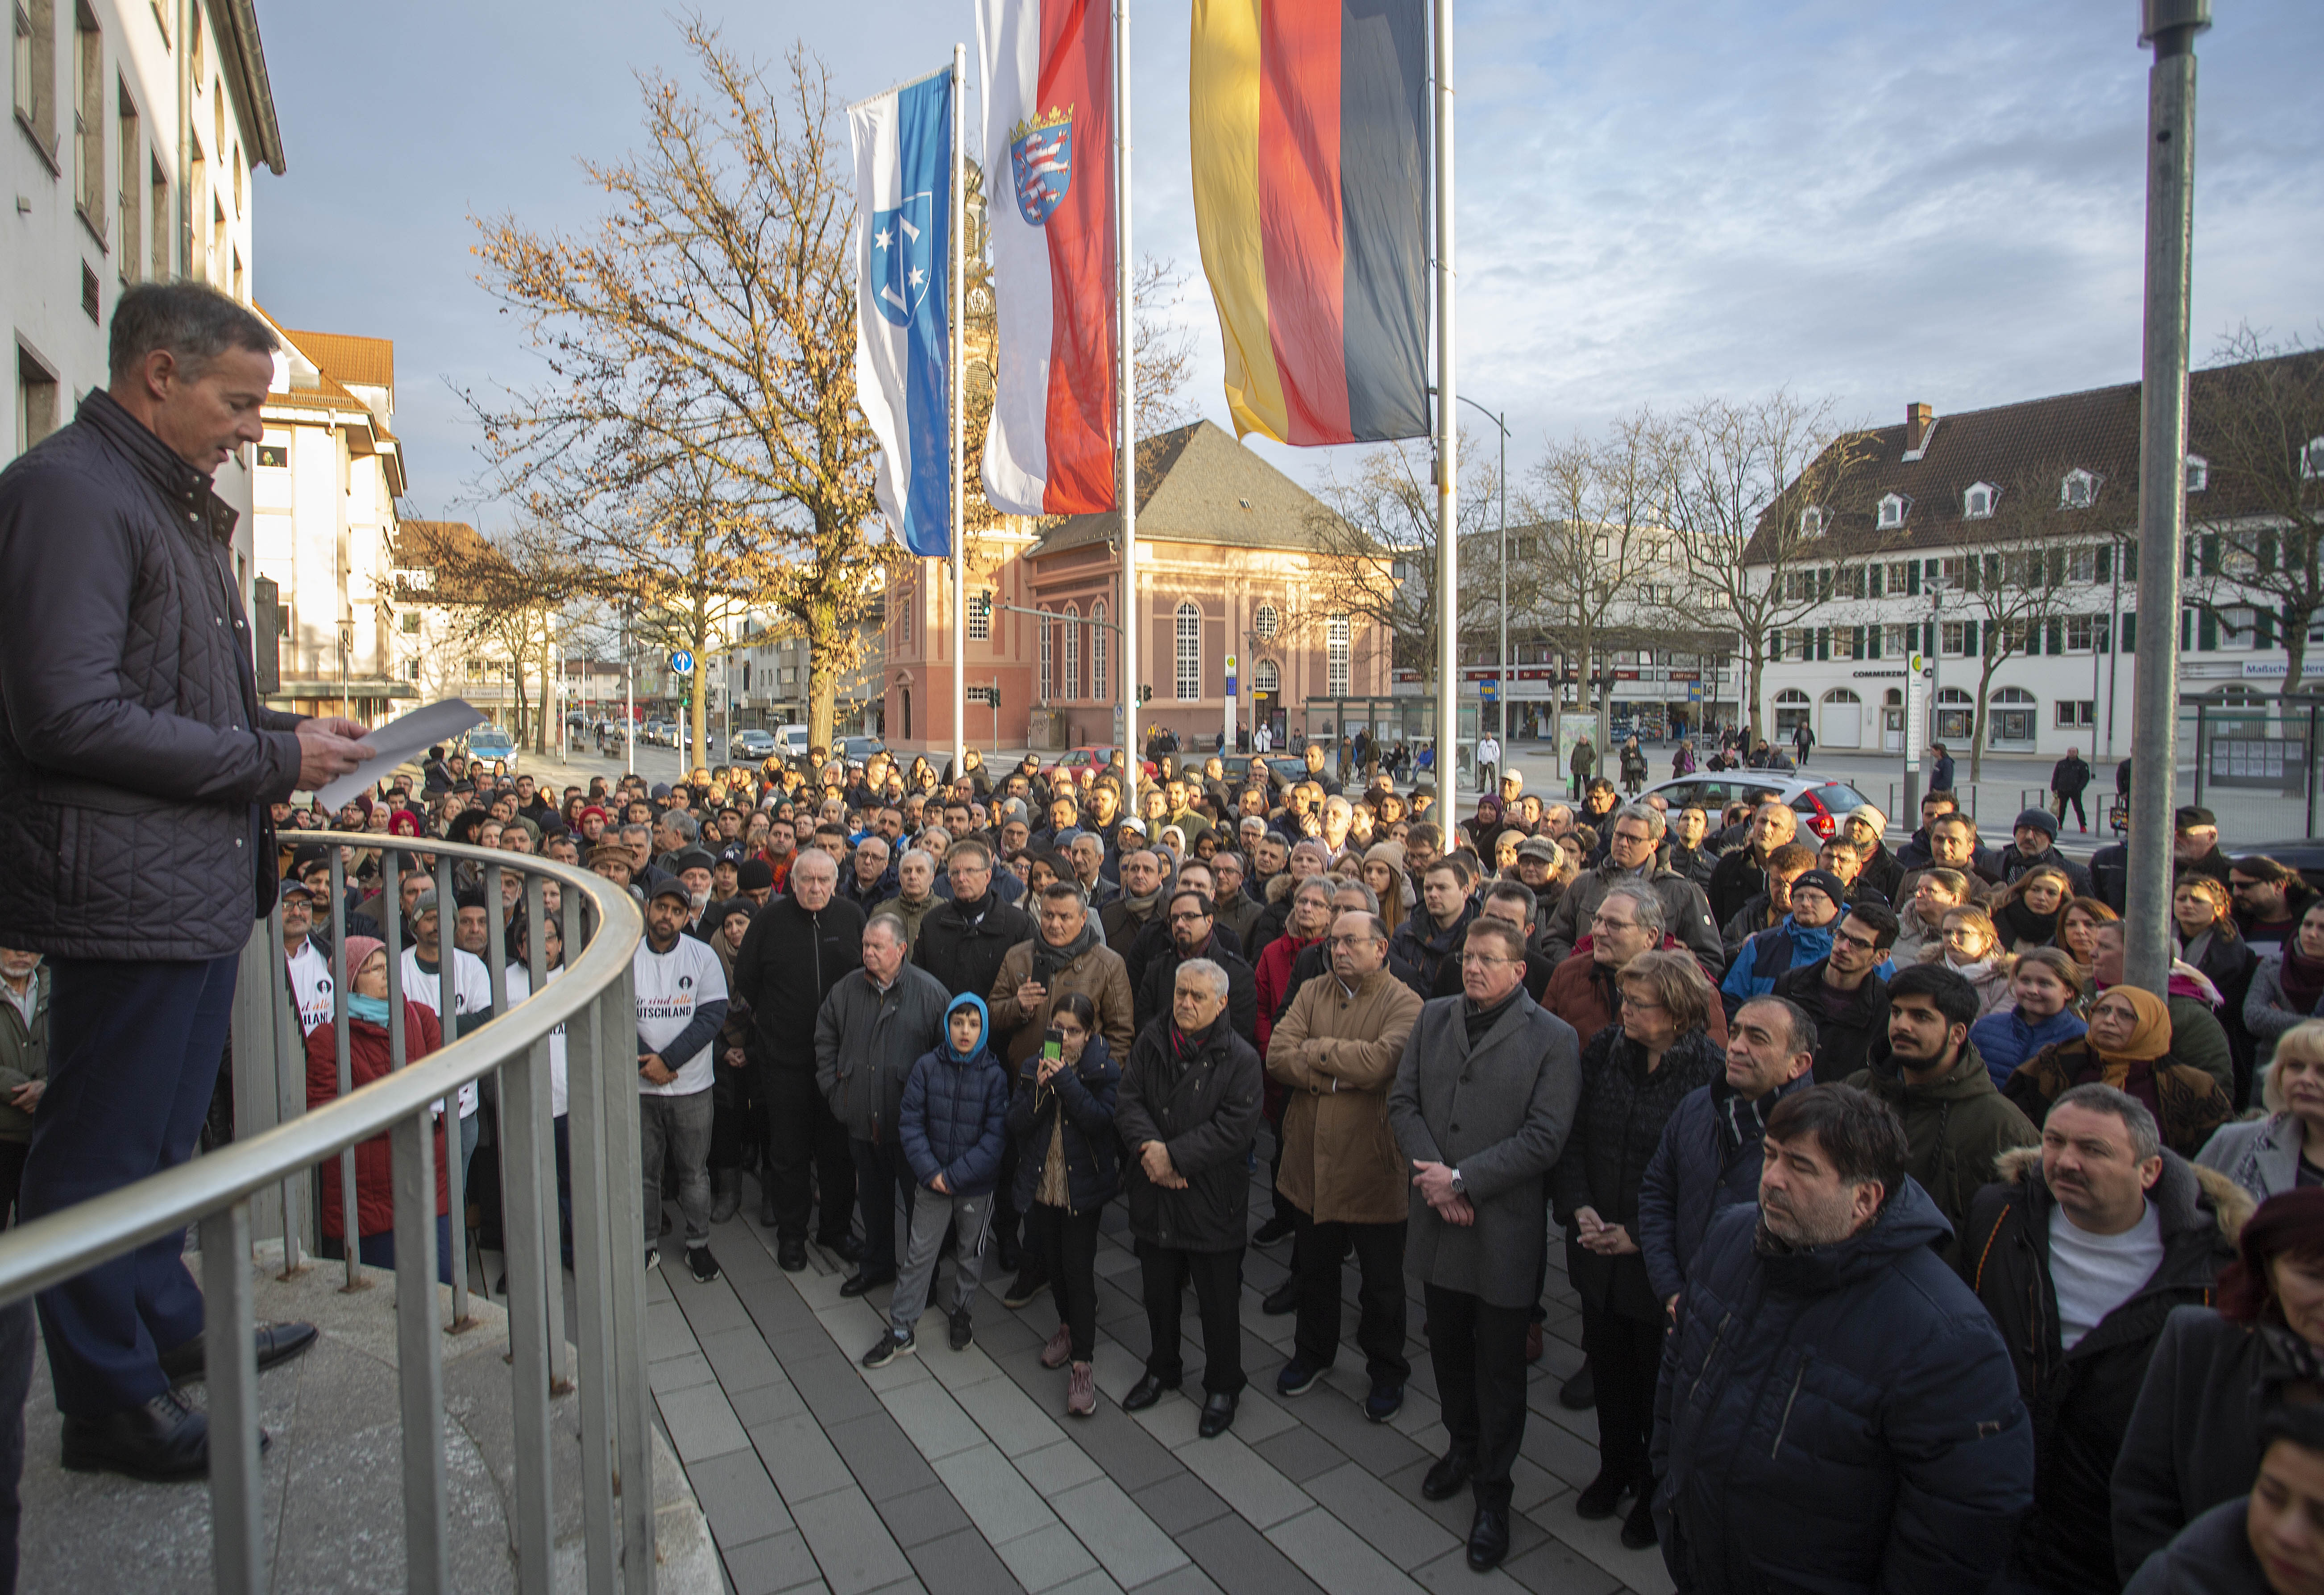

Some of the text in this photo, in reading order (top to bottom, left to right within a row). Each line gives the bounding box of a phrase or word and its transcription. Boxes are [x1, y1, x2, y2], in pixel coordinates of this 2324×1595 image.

[2246, 664, 2324, 673] Maßschdere
[648, 994, 671, 1005] sind
[672, 994, 691, 1005] alle
[636, 1006, 691, 1018] UTSCHLAND
